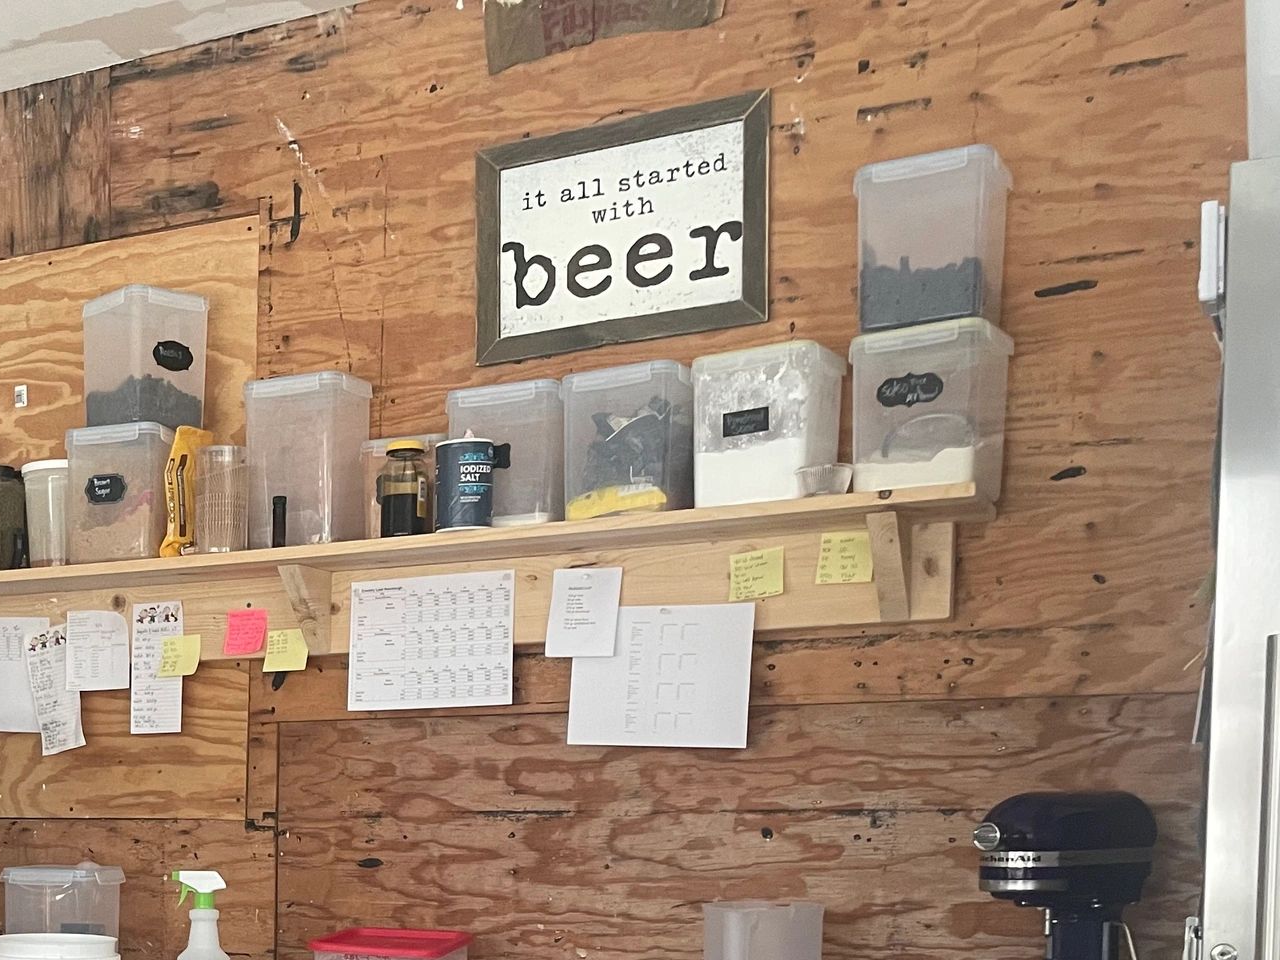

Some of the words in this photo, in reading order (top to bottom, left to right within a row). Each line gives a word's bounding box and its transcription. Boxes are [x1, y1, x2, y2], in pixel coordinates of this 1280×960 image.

[522, 191, 547, 211] it
[560, 178, 605, 203] all
[617, 152, 728, 193] started
[592, 197, 654, 224] with
[502, 220, 743, 309] beer
[460, 465, 492, 473] IODIZED
[460, 473, 480, 482] SALT
